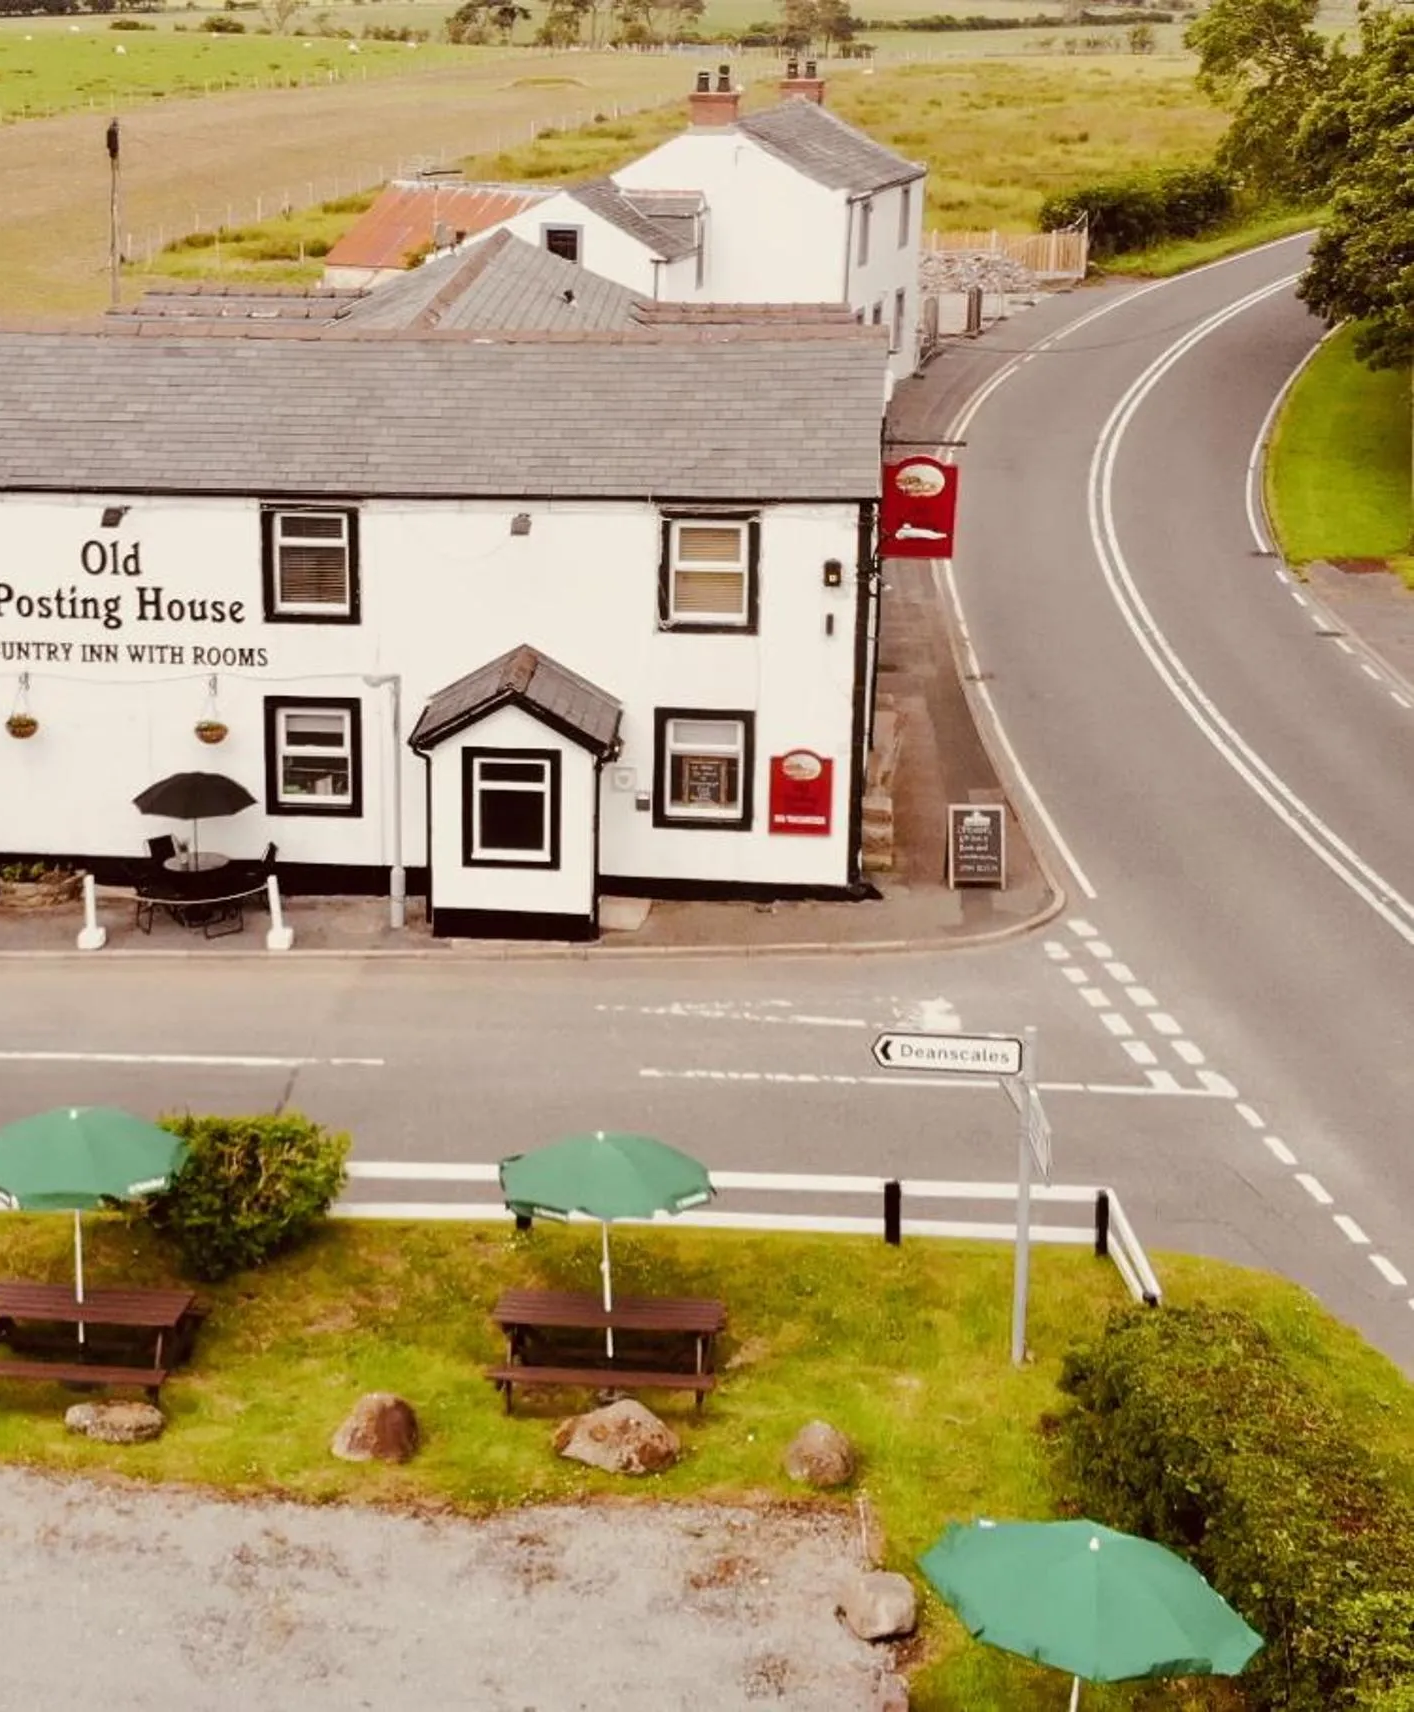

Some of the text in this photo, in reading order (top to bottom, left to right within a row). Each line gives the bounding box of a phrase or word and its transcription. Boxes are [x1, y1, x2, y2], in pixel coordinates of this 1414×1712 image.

[80, 540, 142, 577] Old
[136, 586, 246, 624] House
[81, 643, 119, 664] INN
[126, 644, 185, 666] WITH
[192, 646, 269, 668] ROOMS
[900, 1044, 1010, 1064] Deanscales
